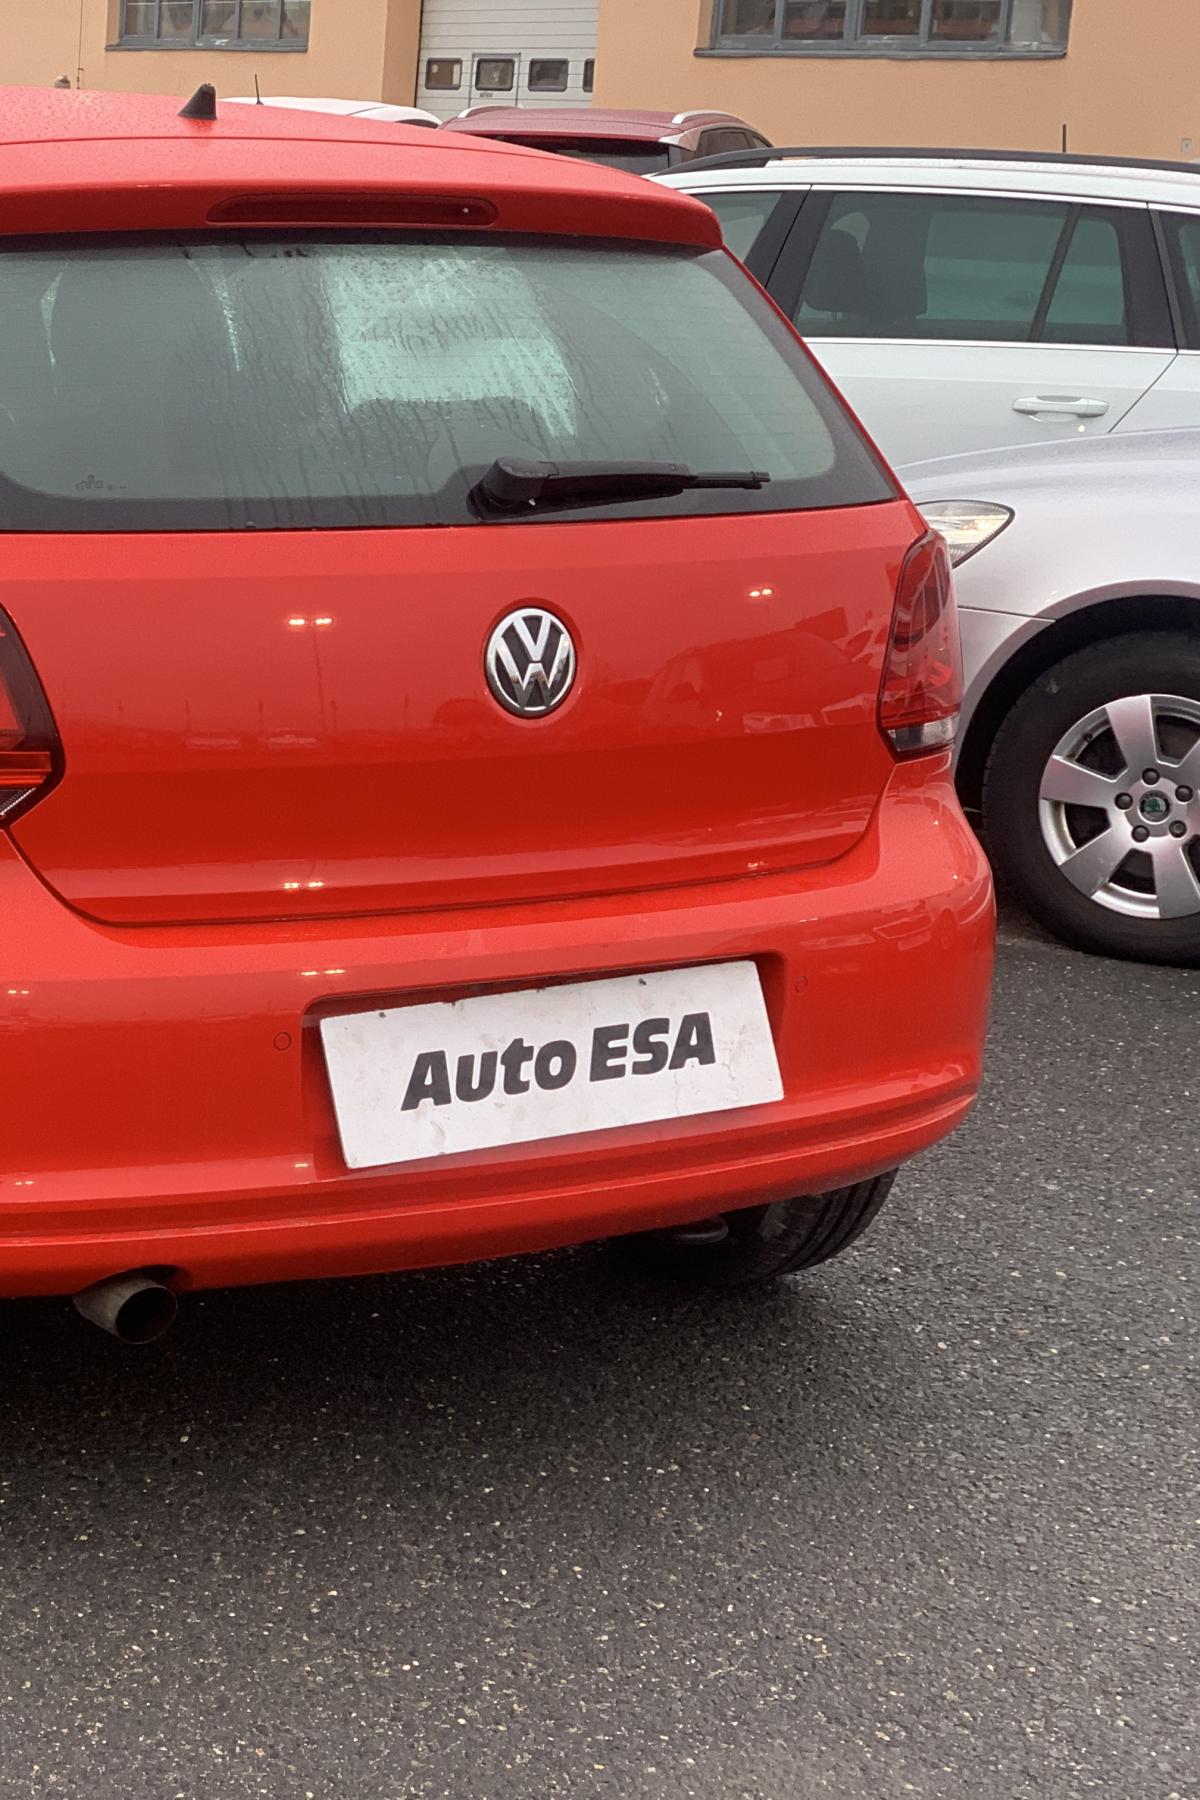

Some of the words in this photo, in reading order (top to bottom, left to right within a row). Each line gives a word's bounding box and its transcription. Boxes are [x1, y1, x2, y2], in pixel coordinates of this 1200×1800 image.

[487, 608, 576, 717] VW
[401, 1038, 577, 1111] Auto
[589, 1012, 716, 1082] ESA
